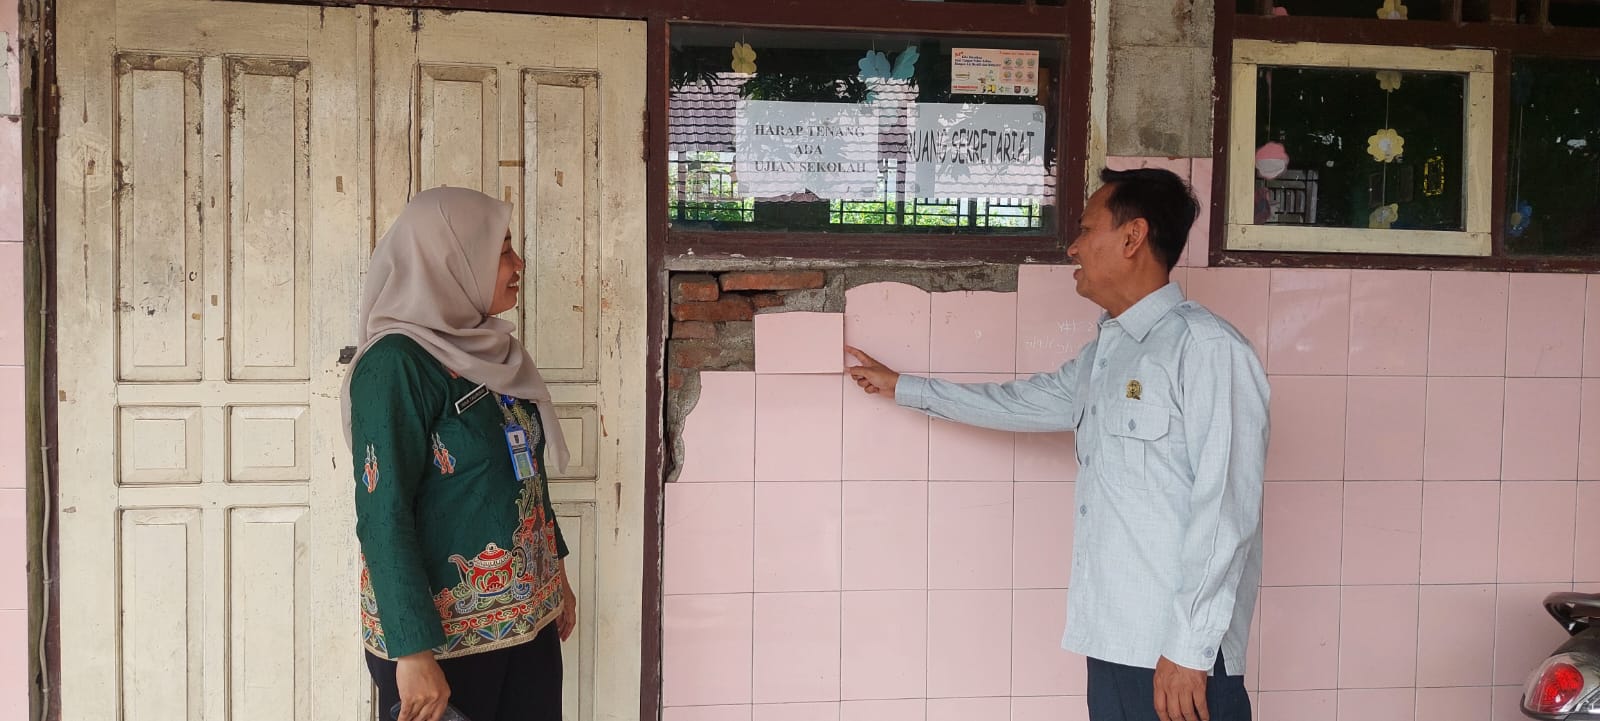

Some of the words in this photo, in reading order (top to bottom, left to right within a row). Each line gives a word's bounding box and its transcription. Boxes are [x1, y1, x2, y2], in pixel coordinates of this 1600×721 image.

[755, 124, 803, 136] HARAP
[807, 125, 865, 137] TENANG
[794, 144, 823, 155] ADA
[951, 128, 1035, 164] SEKRETARIAT
[755, 160, 796, 172] UJIAN
[799, 161, 866, 173] SEKOLAH
